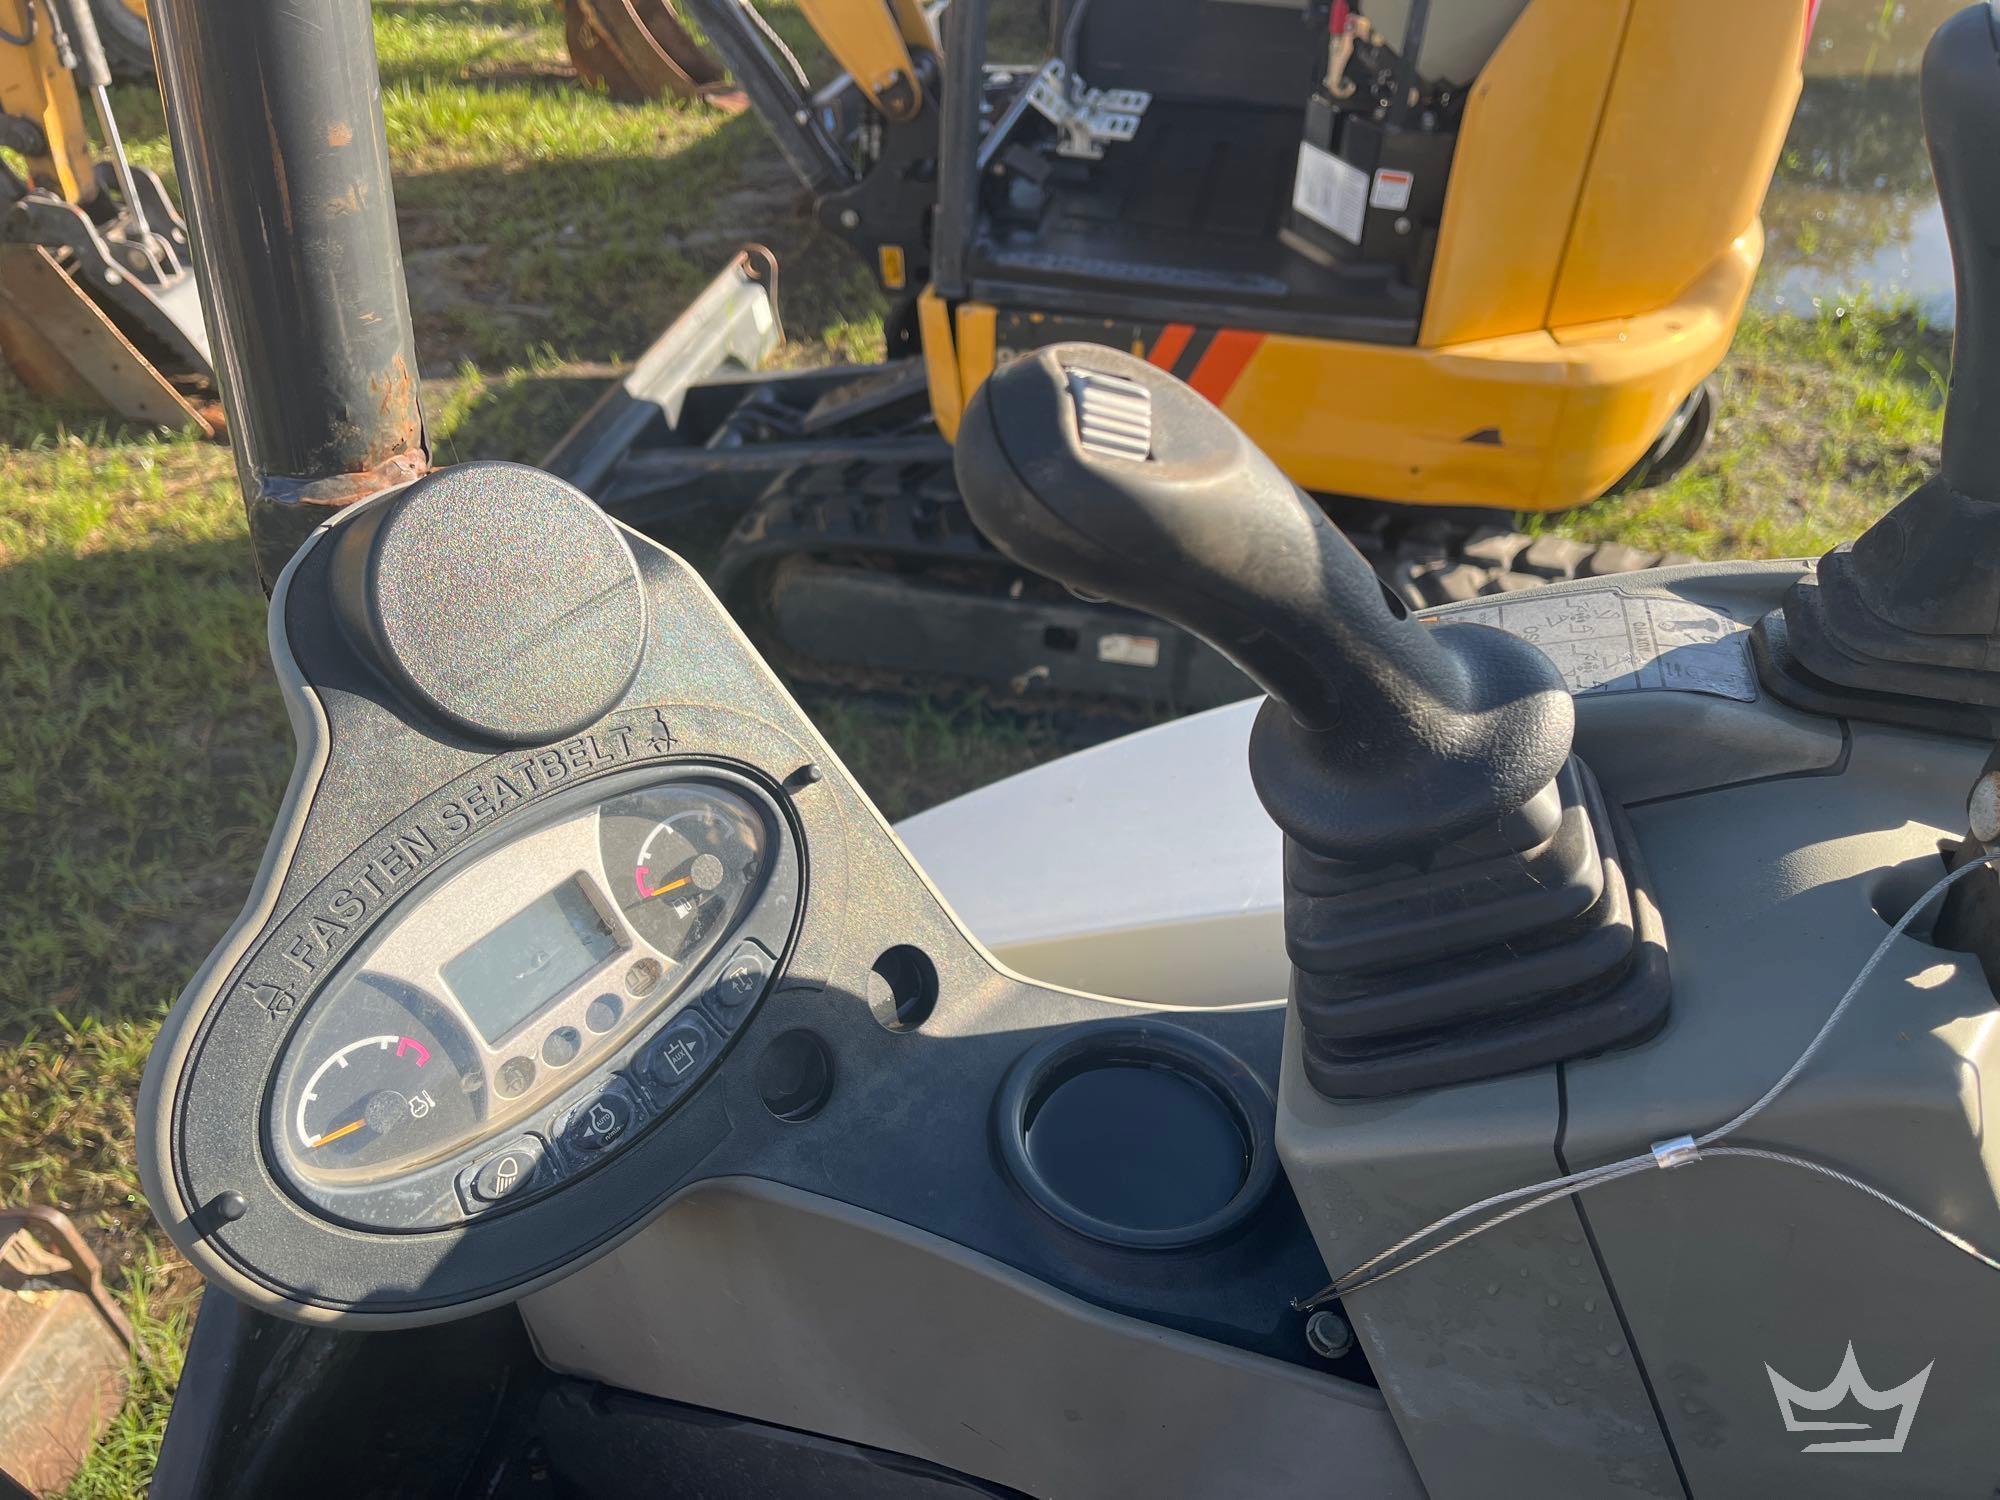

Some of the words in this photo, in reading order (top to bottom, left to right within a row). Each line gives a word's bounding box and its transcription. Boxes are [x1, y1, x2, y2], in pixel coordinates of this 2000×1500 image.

[1636, 638, 1651, 652] AUX
[282, 825, 437, 973] FASTEN
[439, 726, 631, 836] SEATBELT
[672, 1050, 685, 1064] AUX
[596, 1113, 611, 1127] AUTO
[605, 1126, 621, 1141] n/min
